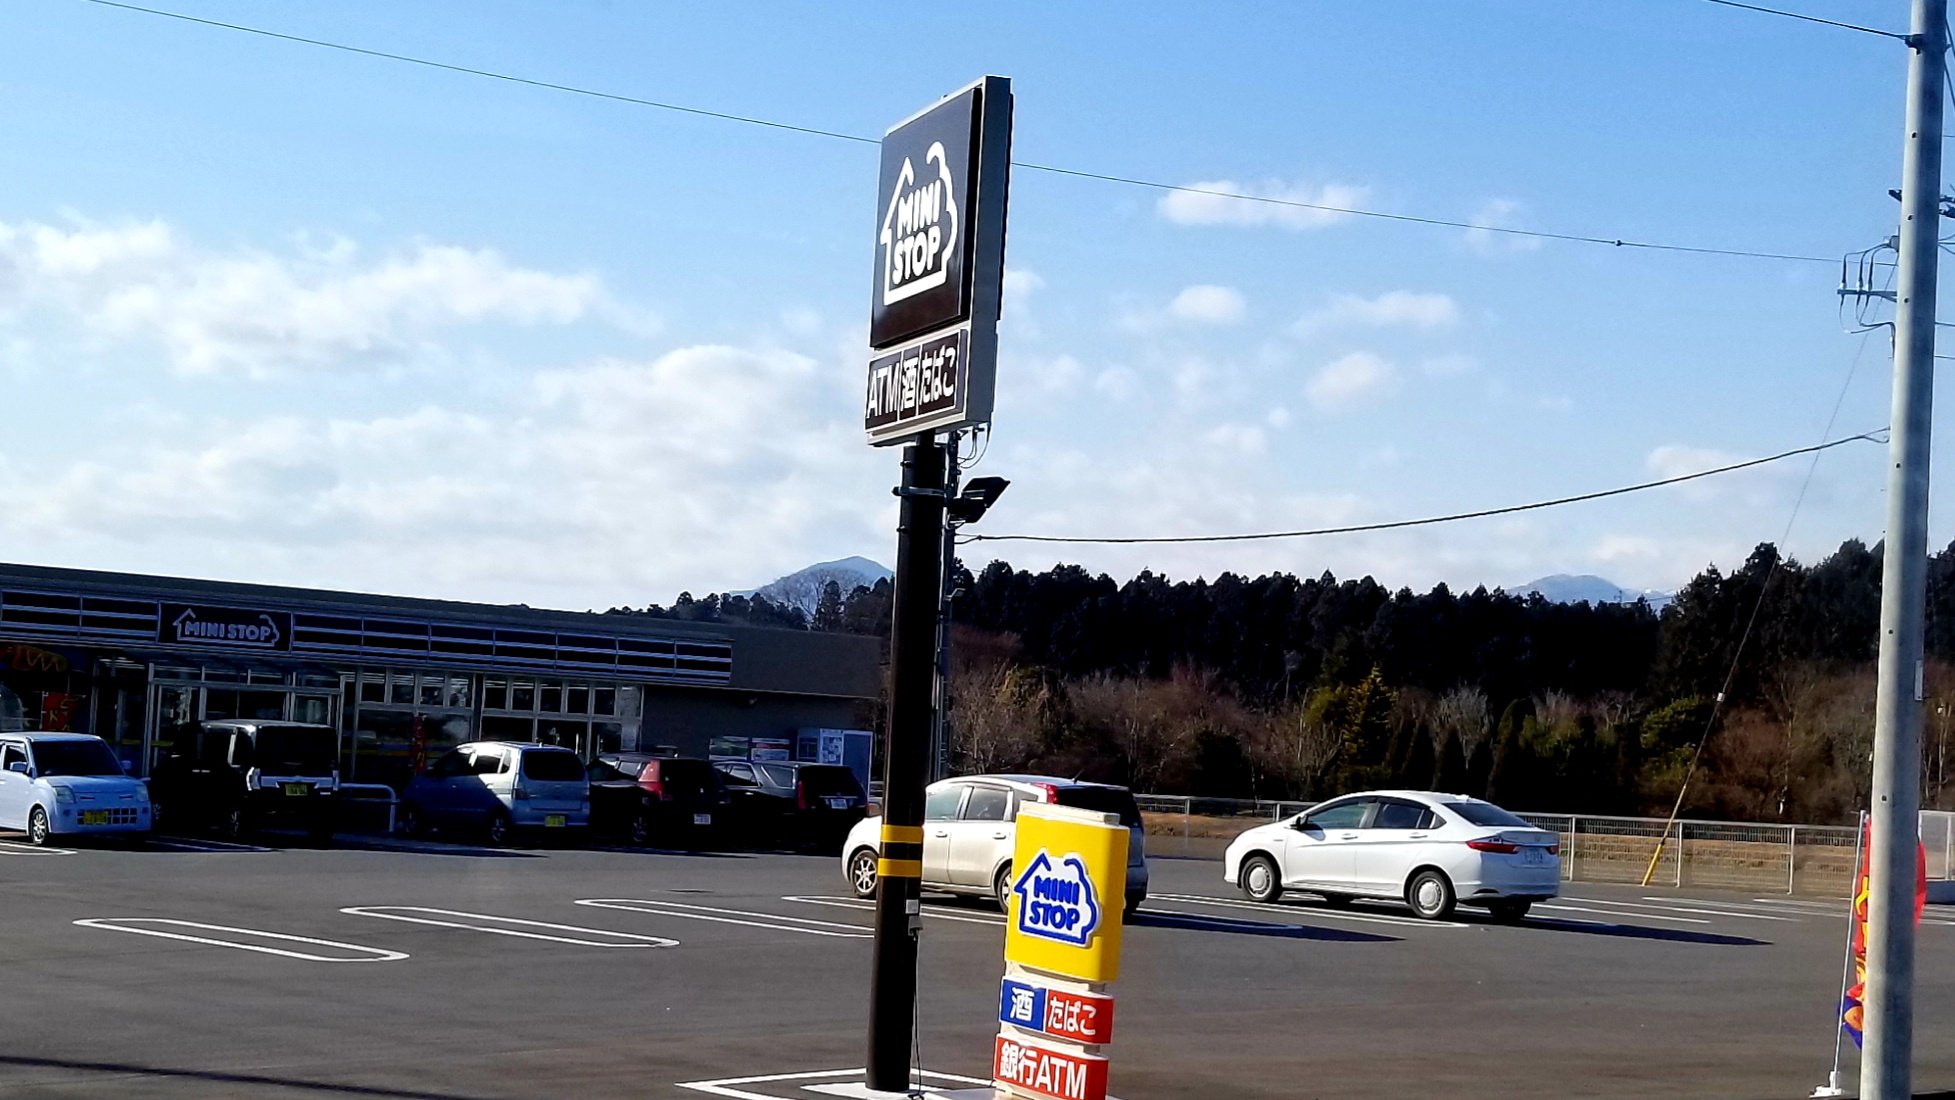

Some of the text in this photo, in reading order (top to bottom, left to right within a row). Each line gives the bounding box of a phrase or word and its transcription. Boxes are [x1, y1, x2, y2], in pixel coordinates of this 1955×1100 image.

[897, 179, 942, 239] MINI
[892, 225, 941, 285] STOP
[866, 345, 956, 419] ATM 酒 たばこ
[184, 621, 271, 641] MINI STOP
[1029, 900, 1080, 931] STOP
[1034, 875, 1080, 906] MINI
[1010, 987, 1097, 1036] 酒 たばこ
[1000, 1041, 1087, 1100] 銀行ATM
